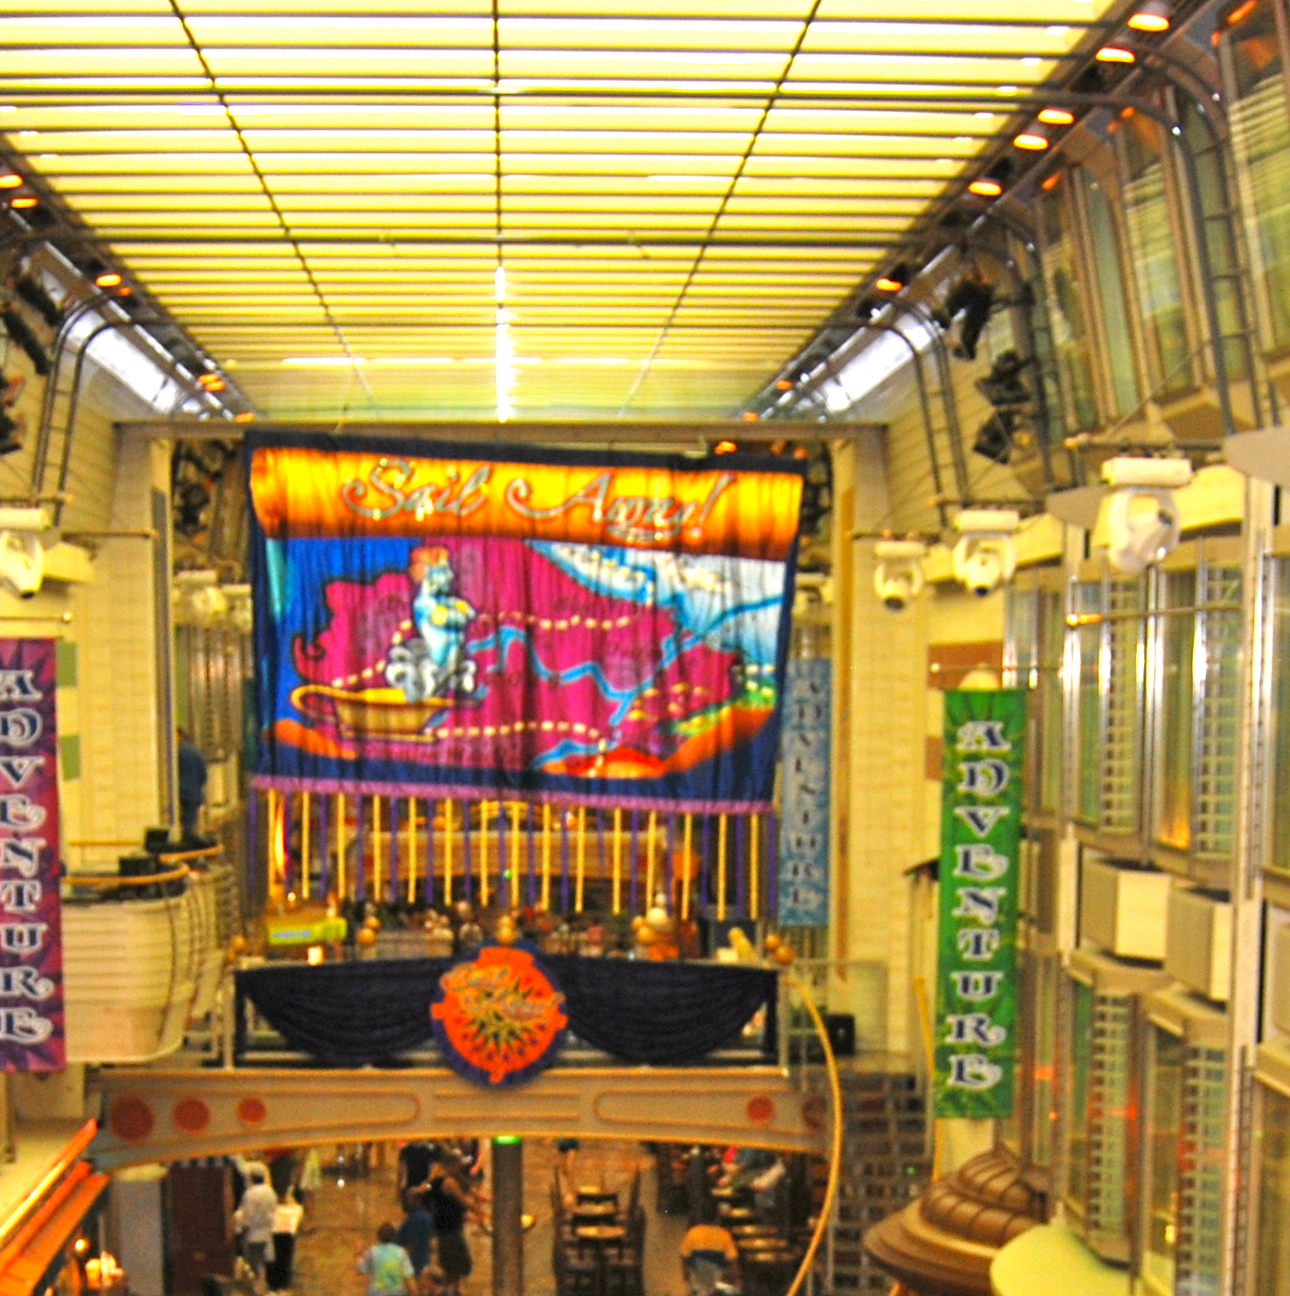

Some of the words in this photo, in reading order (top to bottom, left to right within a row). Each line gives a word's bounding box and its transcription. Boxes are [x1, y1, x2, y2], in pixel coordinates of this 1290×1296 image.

[342, 458, 493, 521] Sail
[507, 466, 737, 541] Away!
[945, 719, 1012, 1091] ADVENTURE
